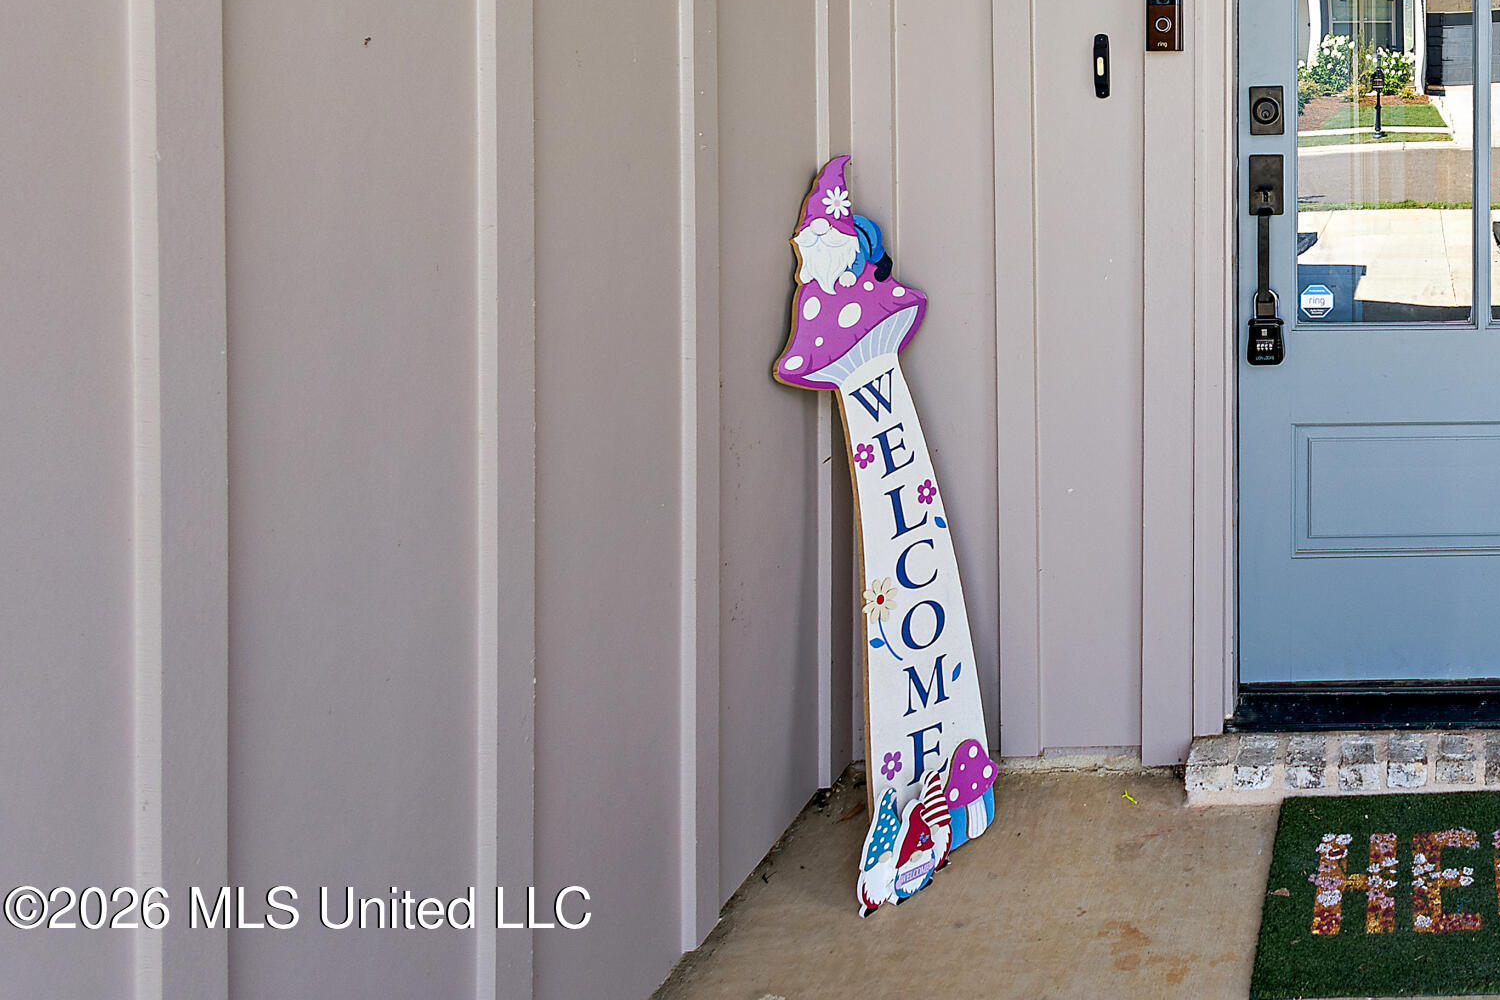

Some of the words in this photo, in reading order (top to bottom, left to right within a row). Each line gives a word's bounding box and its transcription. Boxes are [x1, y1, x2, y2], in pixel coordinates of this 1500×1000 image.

[1157, 40, 1168, 48] ring
[1308, 296, 1325, 306] ring
[849, 368, 950, 787] WELCOME
